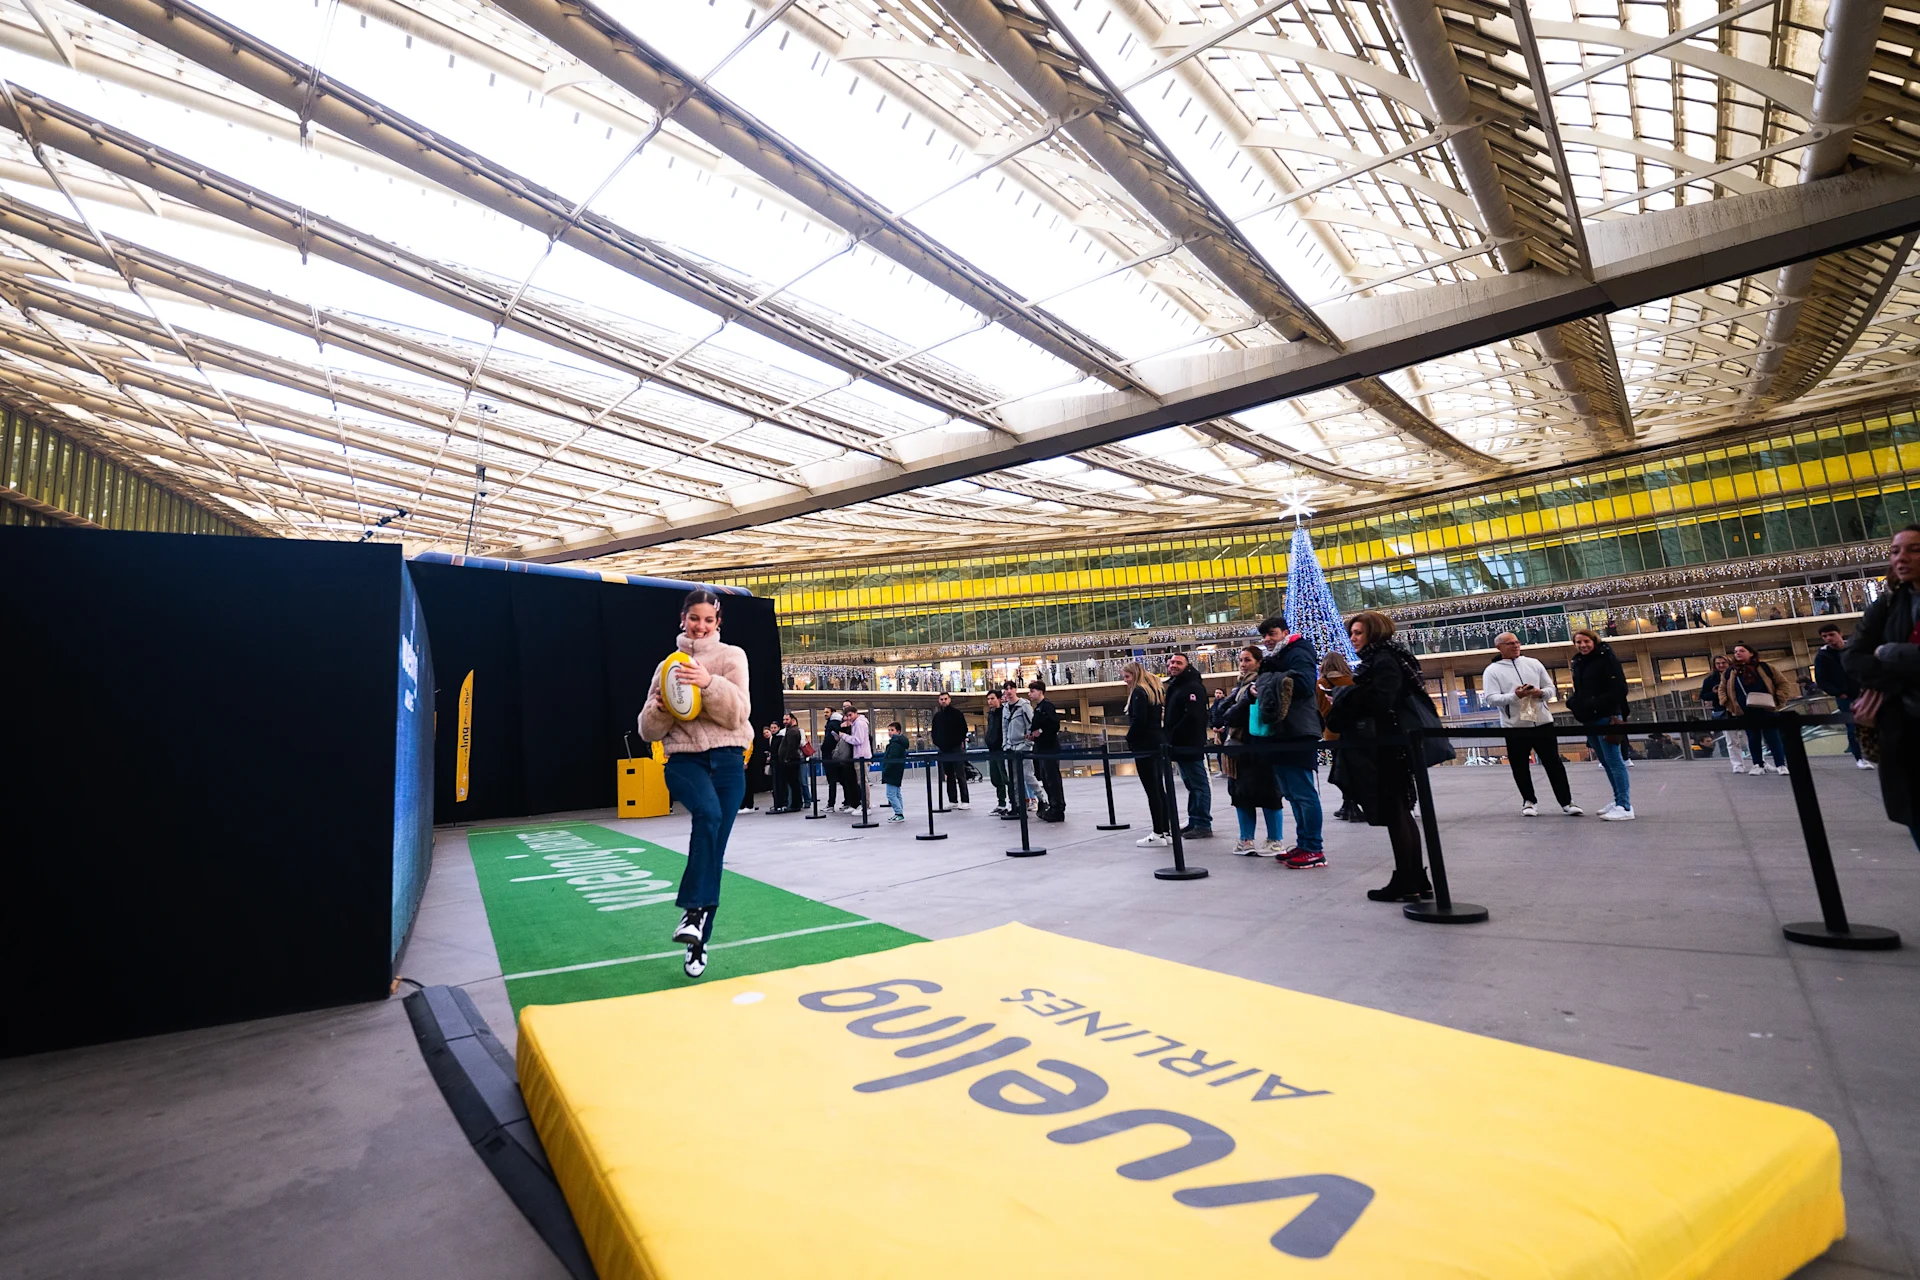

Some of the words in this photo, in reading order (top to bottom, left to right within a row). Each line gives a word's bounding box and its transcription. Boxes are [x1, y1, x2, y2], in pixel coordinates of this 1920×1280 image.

[507, 847, 679, 912] vueling
[1000, 988, 1334, 1101] AIRLINES
[798, 979, 1375, 1259] vueling
